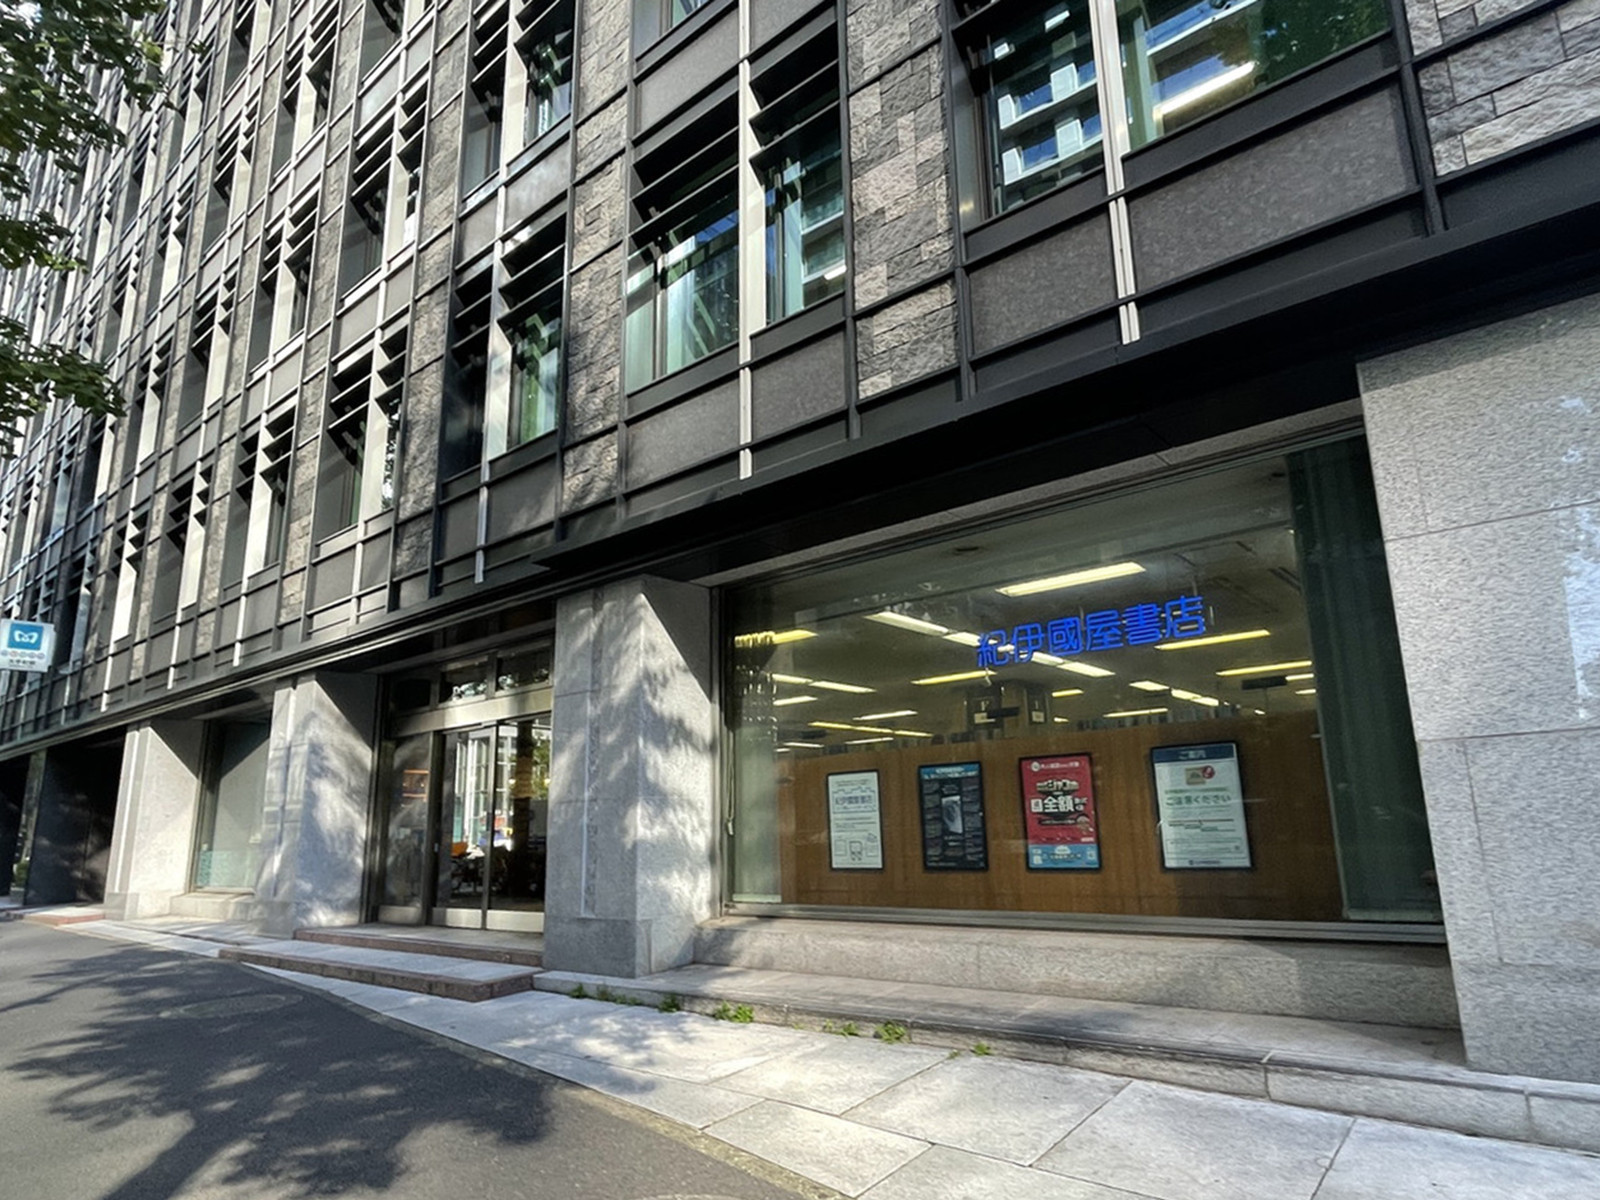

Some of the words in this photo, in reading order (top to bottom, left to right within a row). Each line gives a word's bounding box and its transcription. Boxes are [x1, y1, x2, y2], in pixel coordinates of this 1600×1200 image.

[977, 595, 1206, 667] 紀伊國屋書店
